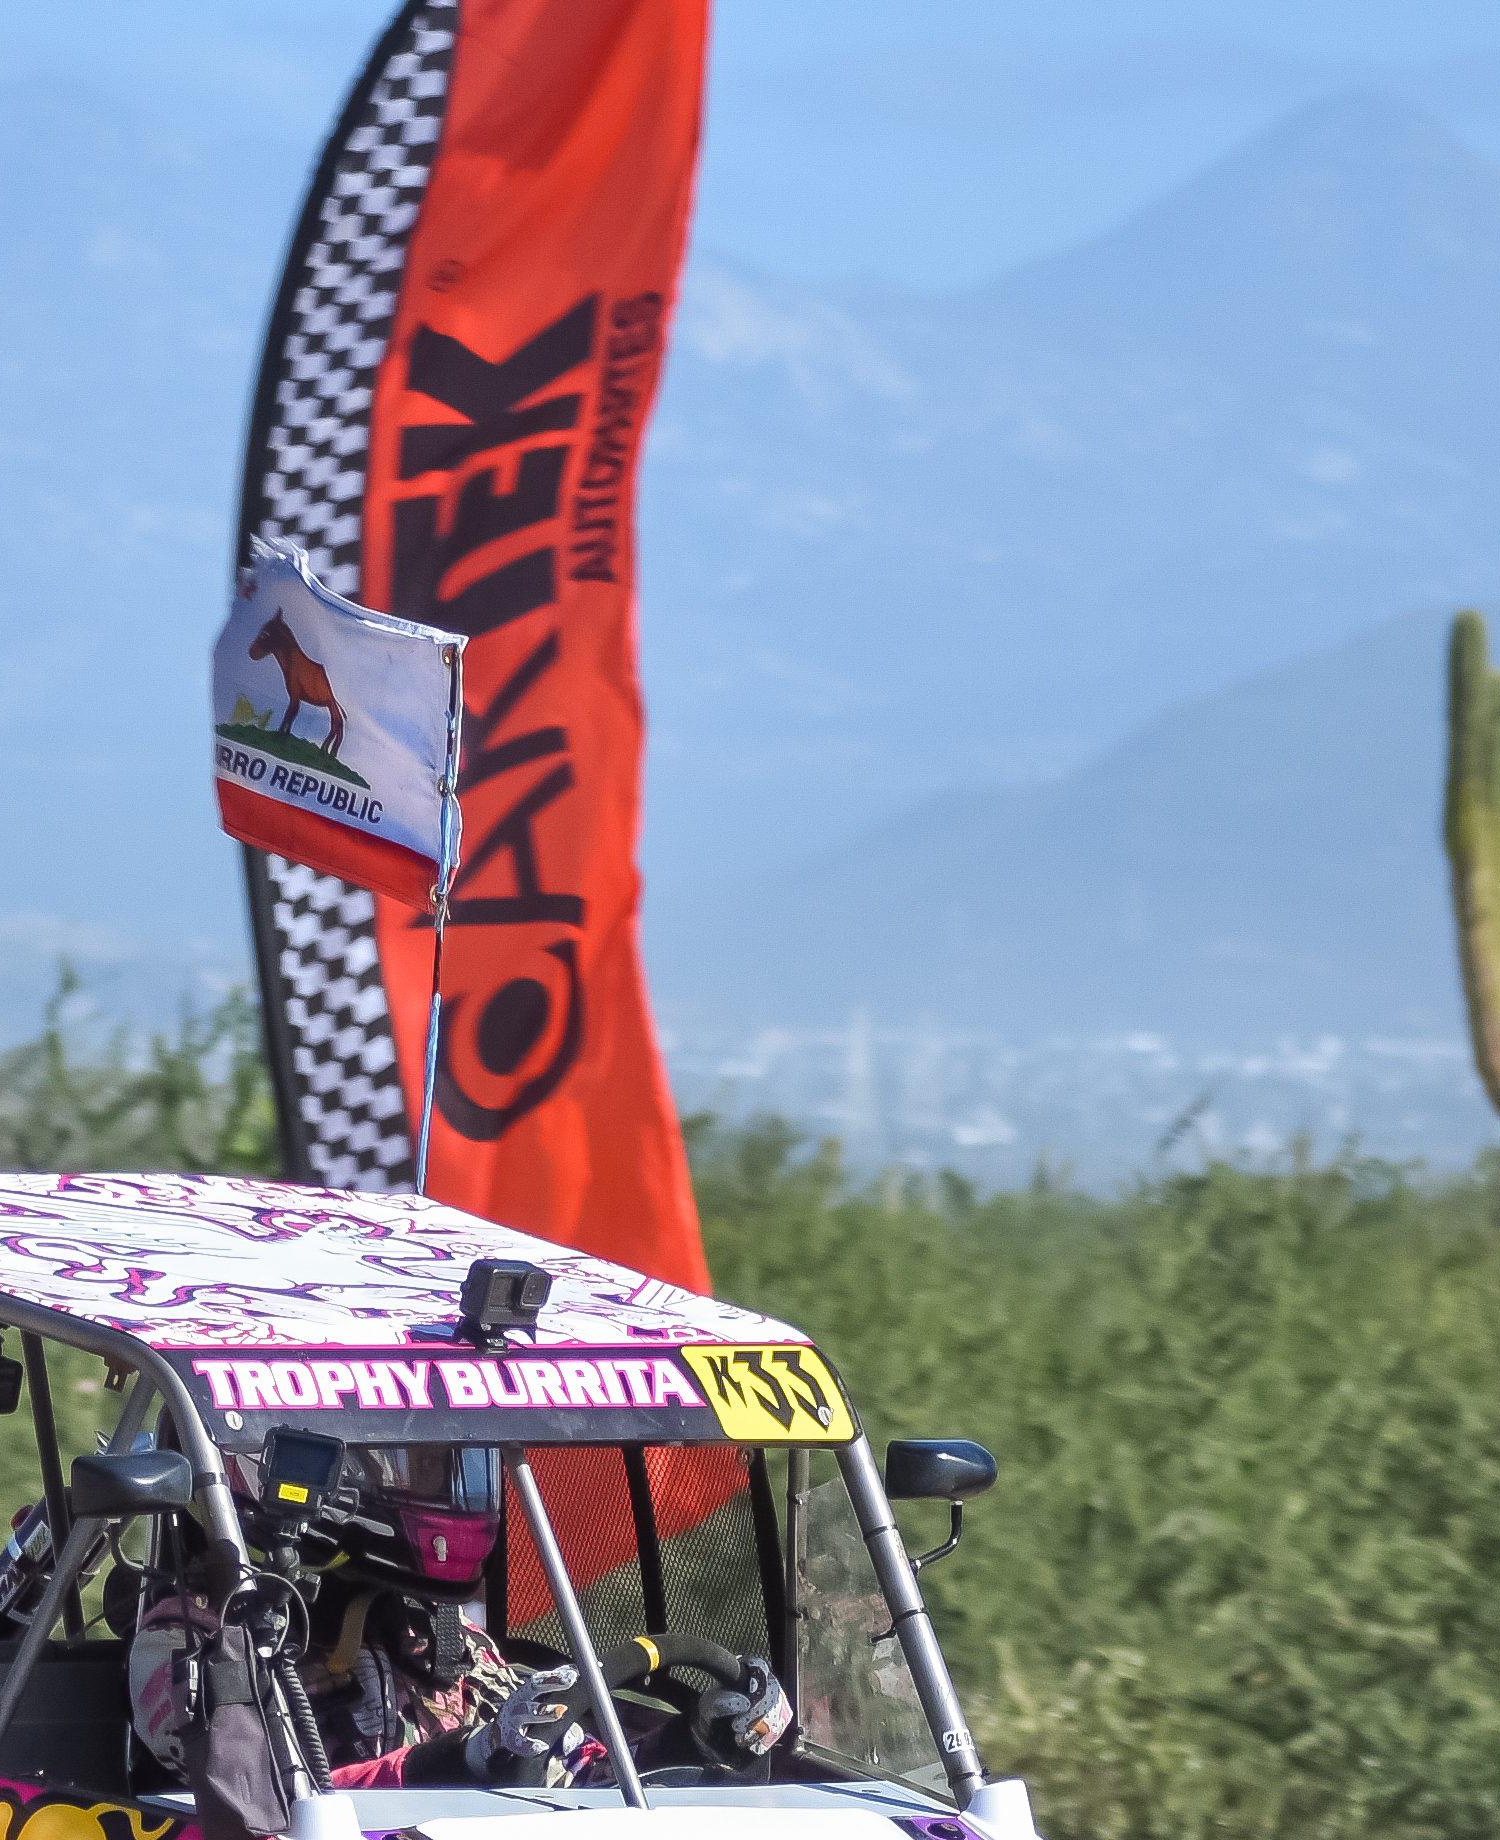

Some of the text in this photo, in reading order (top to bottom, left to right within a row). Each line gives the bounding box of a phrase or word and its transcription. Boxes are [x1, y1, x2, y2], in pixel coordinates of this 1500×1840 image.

[270, 764, 383, 824] REPUBLIC
[193, 1357, 707, 1411] TROPHY BURRITA
